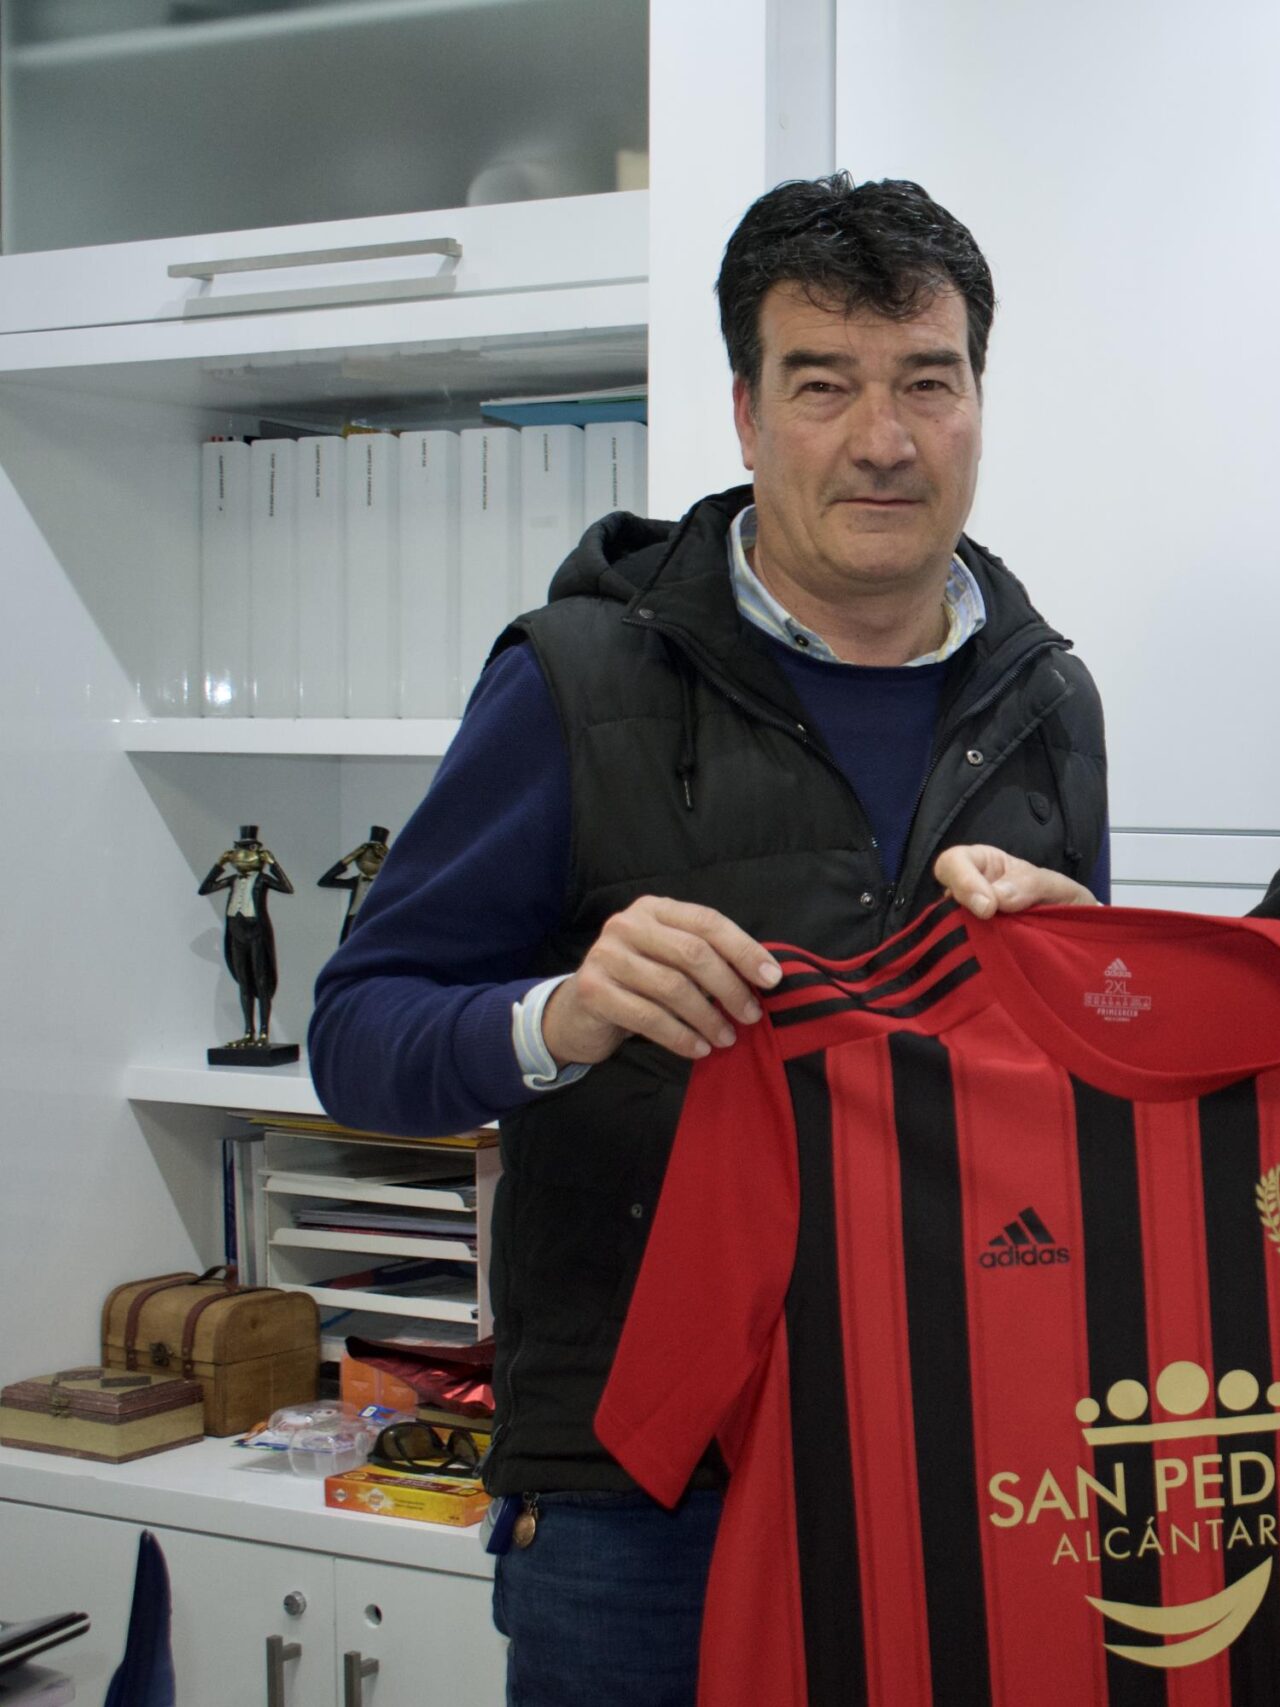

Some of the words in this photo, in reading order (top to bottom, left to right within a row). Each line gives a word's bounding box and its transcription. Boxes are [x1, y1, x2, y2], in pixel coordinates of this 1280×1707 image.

[1105, 979, 1130, 994] 2XL
[980, 1245, 1070, 1268] adidas
[988, 1461, 1128, 1529] SAN
